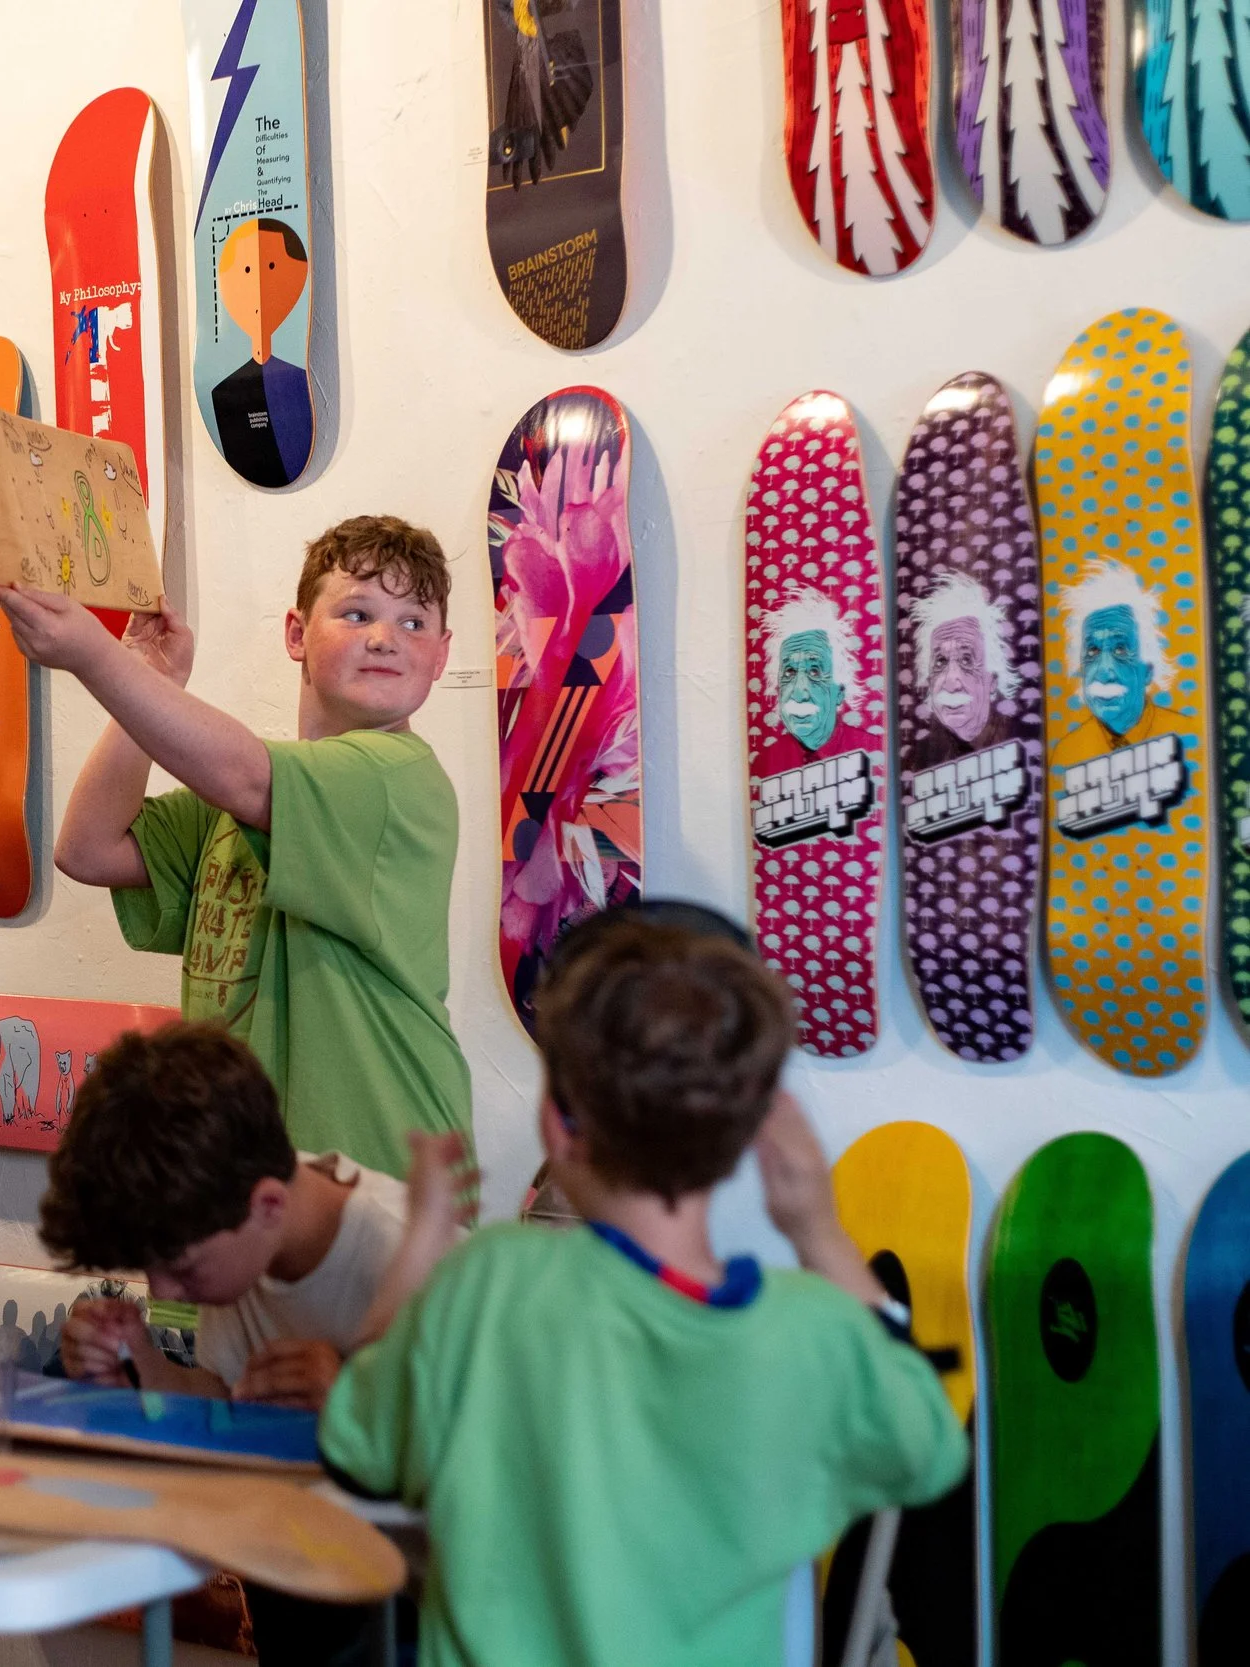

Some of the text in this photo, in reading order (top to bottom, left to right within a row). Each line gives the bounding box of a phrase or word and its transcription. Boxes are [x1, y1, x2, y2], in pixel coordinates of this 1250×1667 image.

[255, 115, 281, 132] The
[255, 132, 288, 143] Difficulties
[255, 145, 266, 156] Of
[256, 154, 290, 165] Measuring
[257, 166, 264, 177] &
[256, 175, 291, 186] Quantifying
[257, 189, 268, 197] The
[233, 199, 258, 213] Chris
[258, 194, 283, 209] Head
[508, 228, 598, 281] BRAINSTORM
[59, 280, 142, 306] My Philosophy:
